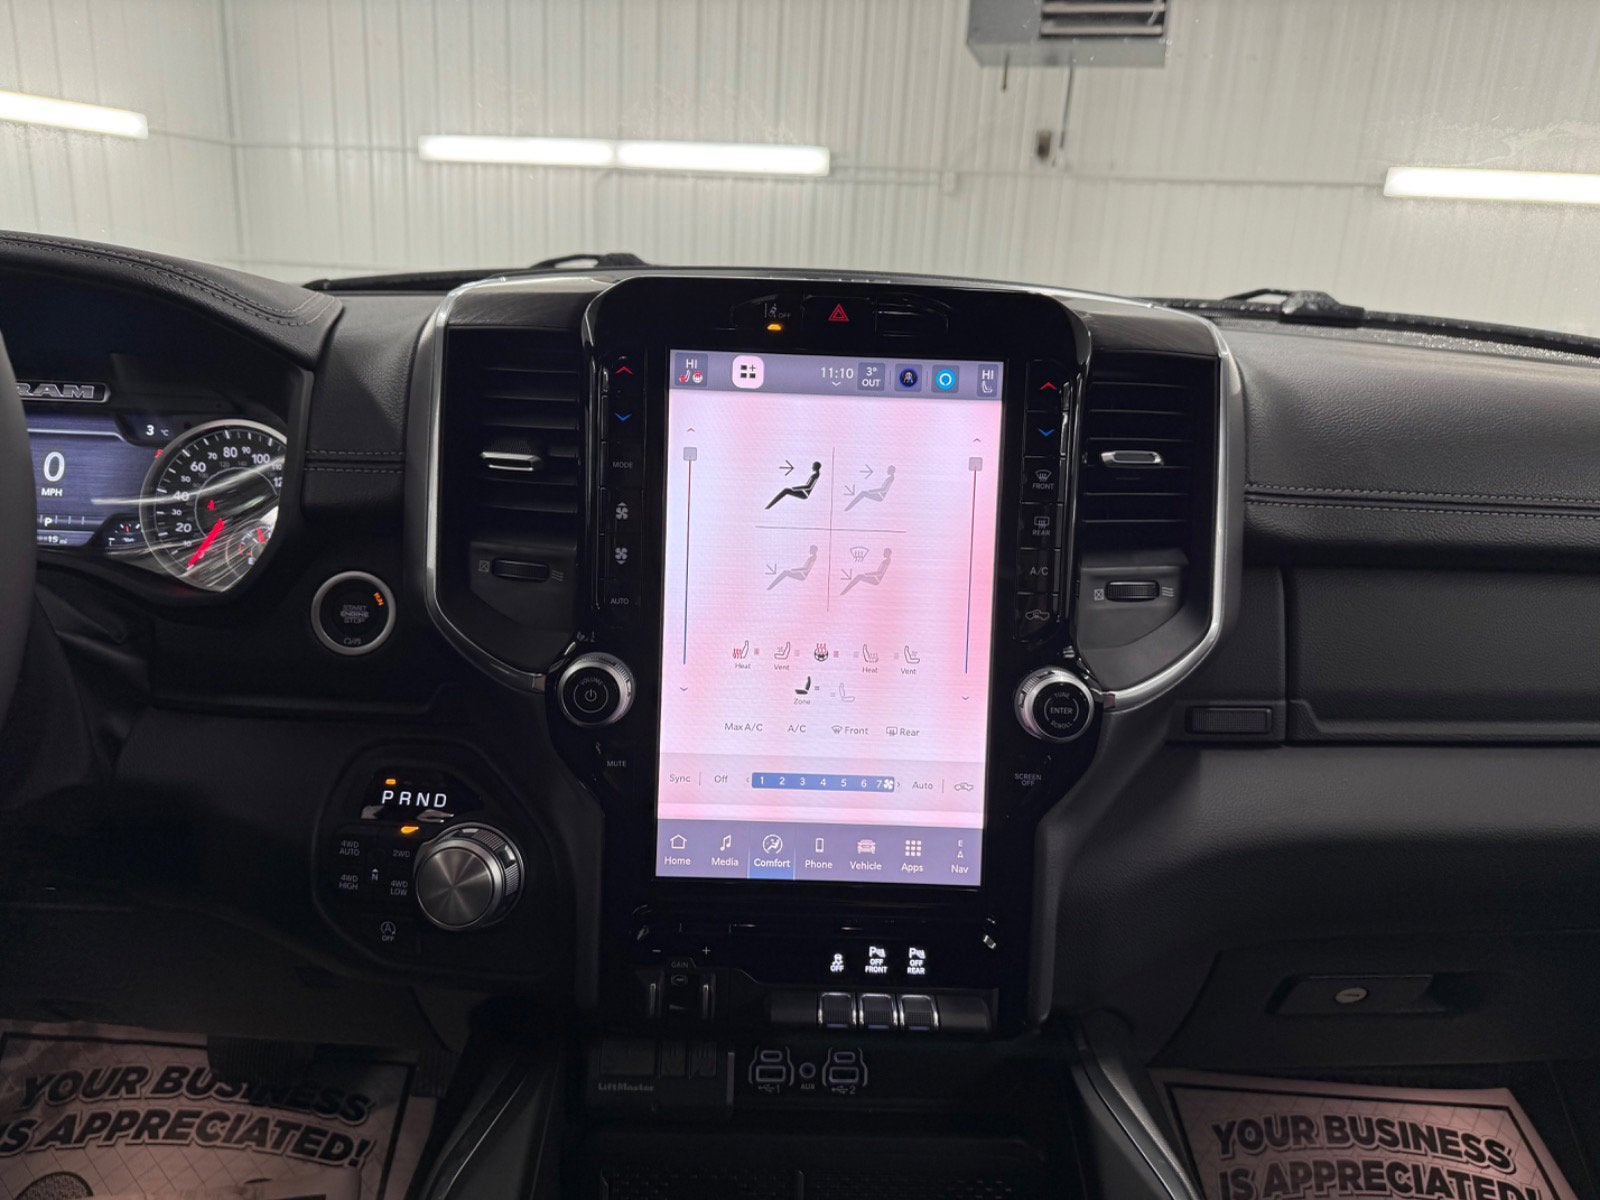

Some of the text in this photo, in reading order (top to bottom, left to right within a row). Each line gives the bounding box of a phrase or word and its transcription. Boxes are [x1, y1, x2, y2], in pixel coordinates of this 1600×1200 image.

[686, 358, 698, 369] HI
[820, 366, 854, 380] 11:10
[981, 369, 994, 380] HI
[861, 378, 881, 388] OUT
[16, 382, 95, 399] RAM
[146, 424, 155, 436] 3
[222, 446, 239, 458] 80
[241, 446, 252, 455] 90
[207, 451, 218, 461] 70
[251, 453, 271, 464] 100
[43, 451, 65, 482] 0
[190, 461, 207, 473] 60
[611, 460, 633, 469] MODE
[180, 475, 192, 484] 50
[1032, 482, 1055, 490] FRONT
[41, 487, 64, 497] MPH
[173, 491, 190, 502] 40
[170, 508, 183, 517] 30
[44, 516, 54, 528] P
[175, 522, 193, 534] 20
[1032, 529, 1051, 537] REAR
[1029, 566, 1049, 576] A/C
[610, 597, 630, 605] AUTO
[735, 662, 752, 670] Heat
[773, 663, 790, 671] Vent
[862, 666, 879, 674] Heat
[900, 667, 917, 675] Vent
[793, 697, 811, 706] Zone
[1050, 706, 1074, 715] ENTER
[724, 722, 763, 732] Max A/C
[787, 724, 806, 733] A/C
[844, 726, 869, 736] Front
[900, 727, 920, 737] Rear
[606, 759, 627, 768] MUTE
[669, 773, 691, 784] Sync
[714, 774, 729, 784] Off
[1014, 772, 1042, 781] SCREEN
[760, 776, 882, 788] 1 2 3 4 5 6 7
[912, 781, 934, 790] Auto
[340, 840, 360, 848] 4WD
[338, 848, 360, 857] AUTO
[392, 849, 411, 858] 2WD
[663, 855, 691, 866] Home
[711, 856, 740, 867] Media
[753, 856, 791, 868] Comfort
[804, 858, 834, 869] Phone
[849, 860, 883, 871] Vehicle
[901, 863, 924, 874] Apps
[950, 864, 969, 874] Nav
[340, 874, 359, 882] 4WD
[338, 882, 359, 891] HIGH
[390, 880, 409, 888] 4WD
[389, 888, 408, 897] LOW
[670, 961, 690, 969] GAIN
[869, 958, 884, 966] OFF
[909, 959, 924, 967] OFF
[829, 964, 845, 973] OFF
[865, 965, 889, 974] FRONT
[906, 966, 926, 975] REAR
[20, 1065, 371, 1123] YOUR BUSESS
[0, 1109, 370, 1167] S APPRECIATED!
[1211, 1114, 1512, 1170] YOUR BUSINESS
[1219, 1167, 1255, 1200] IS
